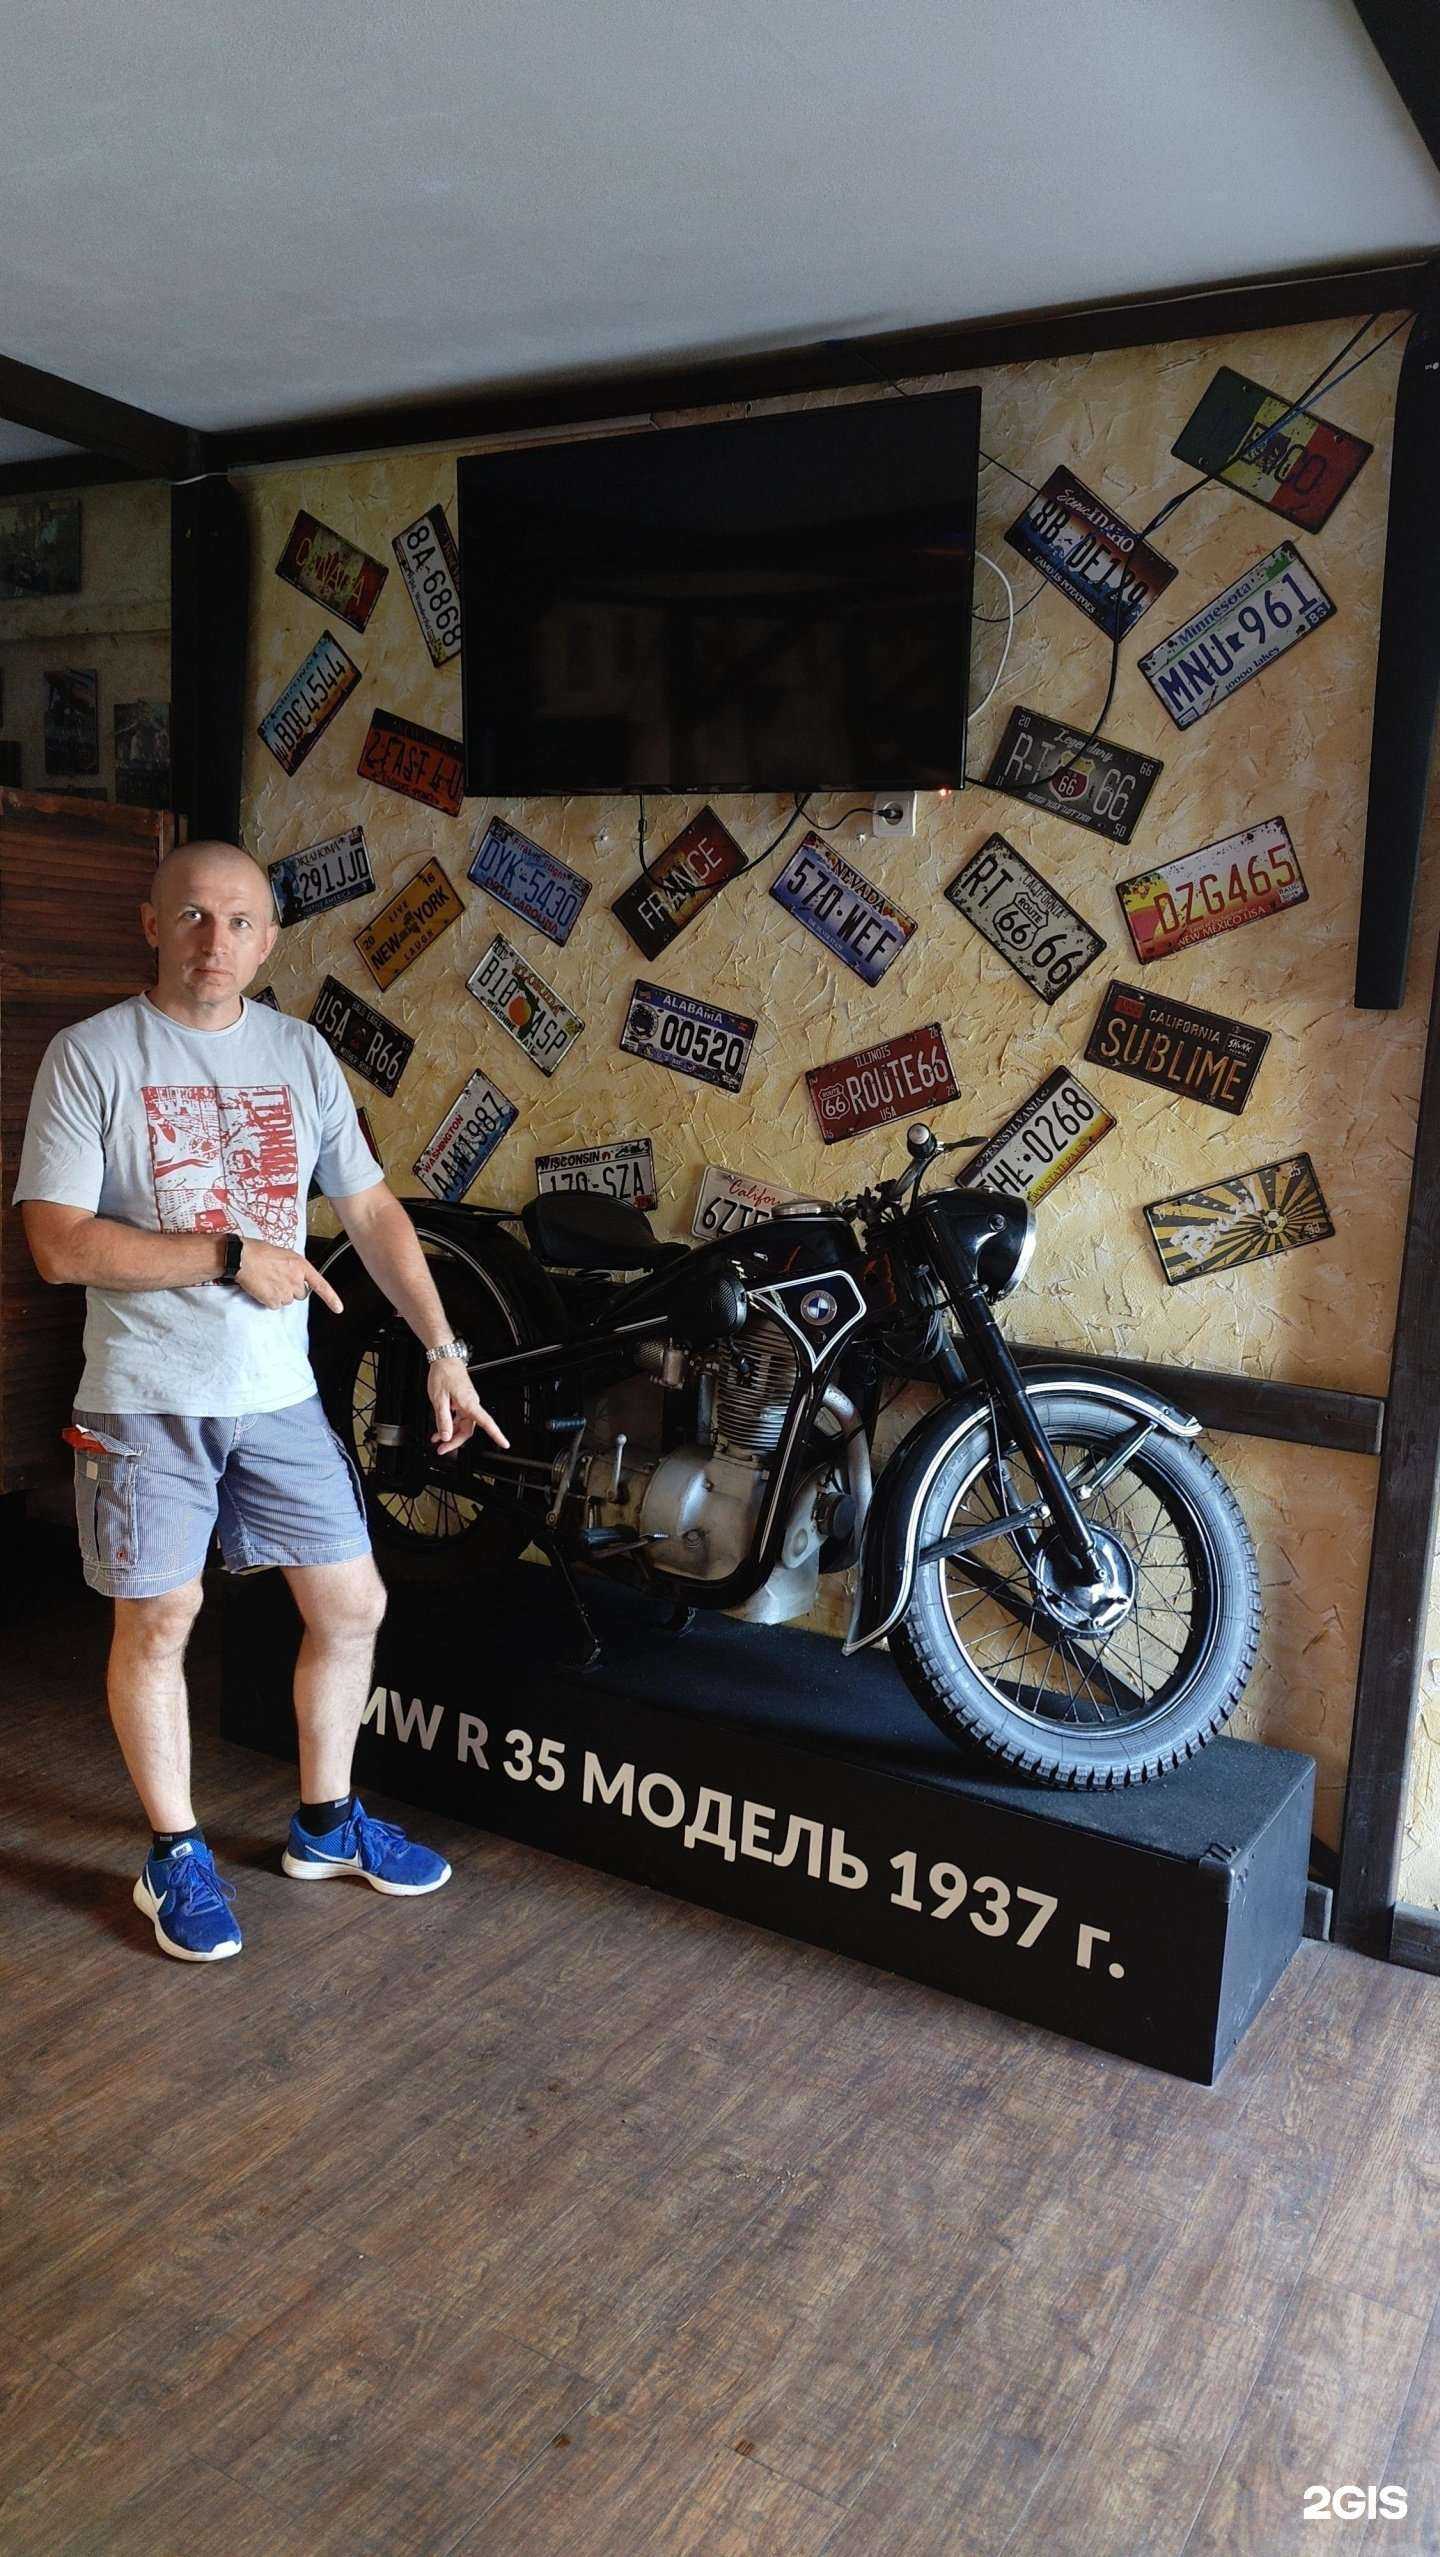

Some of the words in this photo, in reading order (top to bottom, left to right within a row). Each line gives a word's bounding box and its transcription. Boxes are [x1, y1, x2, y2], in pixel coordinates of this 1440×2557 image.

[1156, 632, 1237, 712] MNU
[1234, 566, 1318, 650] 961
[1176, 579, 1252, 646] Minnesota
[1056, 774, 1078, 796] 66
[297, 845, 370, 903] 291JJD
[636, 837, 723, 931] FRANCE
[831, 858, 890, 915] NEVADA
[959, 851, 1015, 913] RT
[1021, 872, 1066, 920] CALIFORNIA
[1151, 842, 1297, 935] DZG465
[369, 931, 403, 971] NEW
[412, 883, 449, 928] YORK
[995, 904, 1035, 947] 66
[1016, 896, 1043, 924] ROUTE
[1200, 913, 1242, 937] MEXICO
[1027, 925, 1087, 988] 66
[313, 989, 353, 1043] USA
[363, 1030, 404, 1084] R66
[525, 1007, 569, 1061] ASP
[657, 1011, 746, 1076] 00520
[853, 1044, 892, 1068] ILLINOIS
[1147, 1008, 1223, 1045] CALIFORNIA
[1097, 1014, 1248, 1102] SUBLIME
[822, 1094, 847, 1117] 66
[878, 1104, 897, 1121] USA
[980, 1094, 1044, 1162] PENNSYLVANIA
[422, 1111, 464, 1176] WASHINGTON
[458, 1712, 491, 1770] R
[503, 1728, 567, 1791] 35
[582, 1751, 870, 1892] МОДЕЛЬ
[889, 1850, 1058, 1949] 1937
[1075, 1924, 1126, 1980] г.
